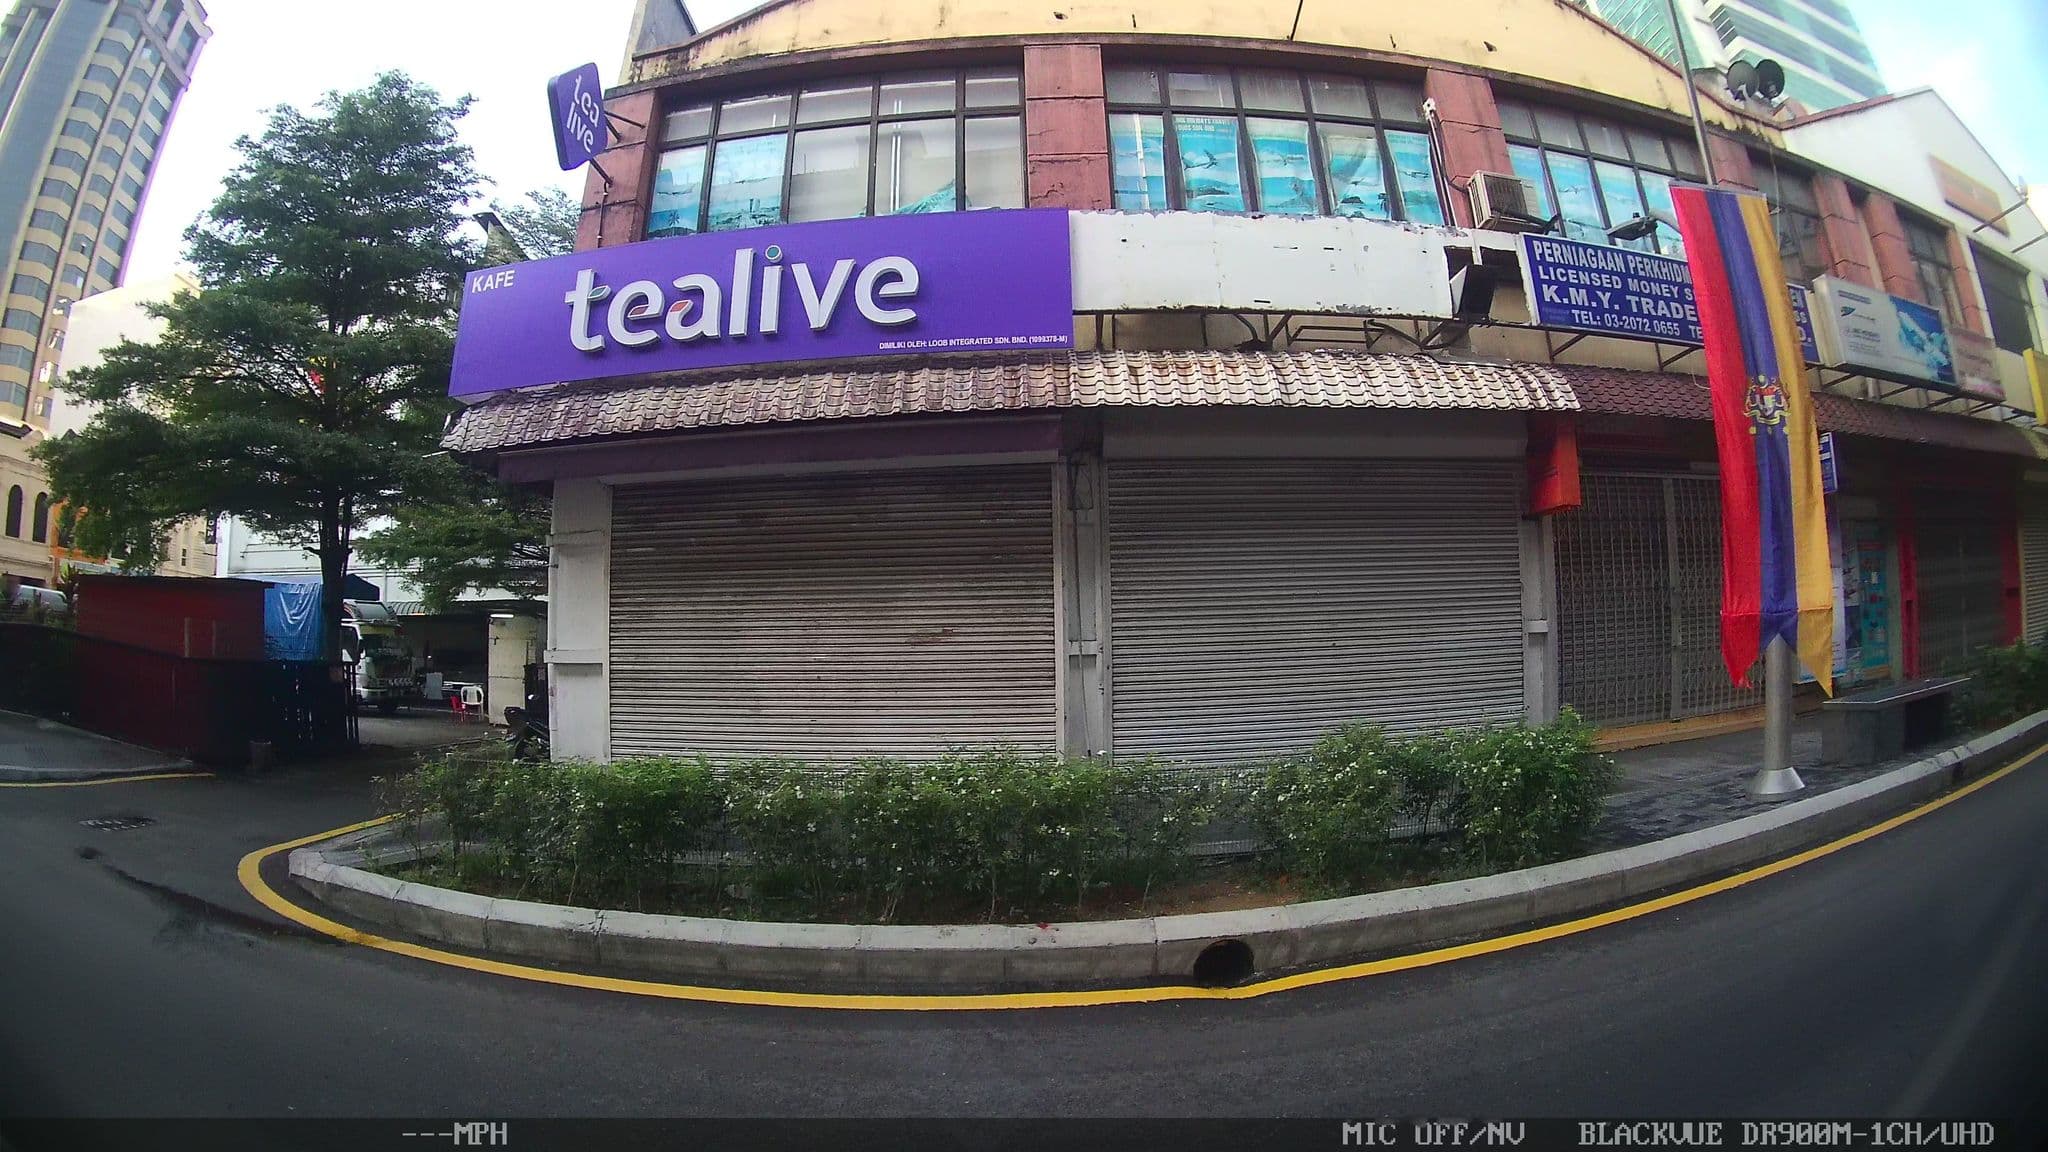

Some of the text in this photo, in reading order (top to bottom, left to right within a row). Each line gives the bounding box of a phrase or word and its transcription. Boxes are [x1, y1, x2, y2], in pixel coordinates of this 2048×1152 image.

[573, 74, 600, 128] tea
[566, 101, 594, 153] live
[1532, 240, 1693, 285] PERNIAGAAN PERKHIDM
[471, 270, 516, 294] KAFE
[564, 244, 920, 352] tealive
[1538, 265, 1622, 290] LICENSED
[1627, 277, 1680, 299] MONEY
[1542, 284, 1620, 311] K.M.Y.
[1626, 294, 1699, 322] TRADE
[1571, 309, 1601, 326] TEL:
[1603, 312, 1651, 332] 03-2072
[1653, 323, 1681, 337] 0655
[879, 341, 906, 350] DIMILIKI
[906, 340, 928, 349] OLEH:
[928, 339, 949, 348] LOOB
[949, 336, 994, 347] INTEGRATED
[994, 336, 1011, 345] SDN.
